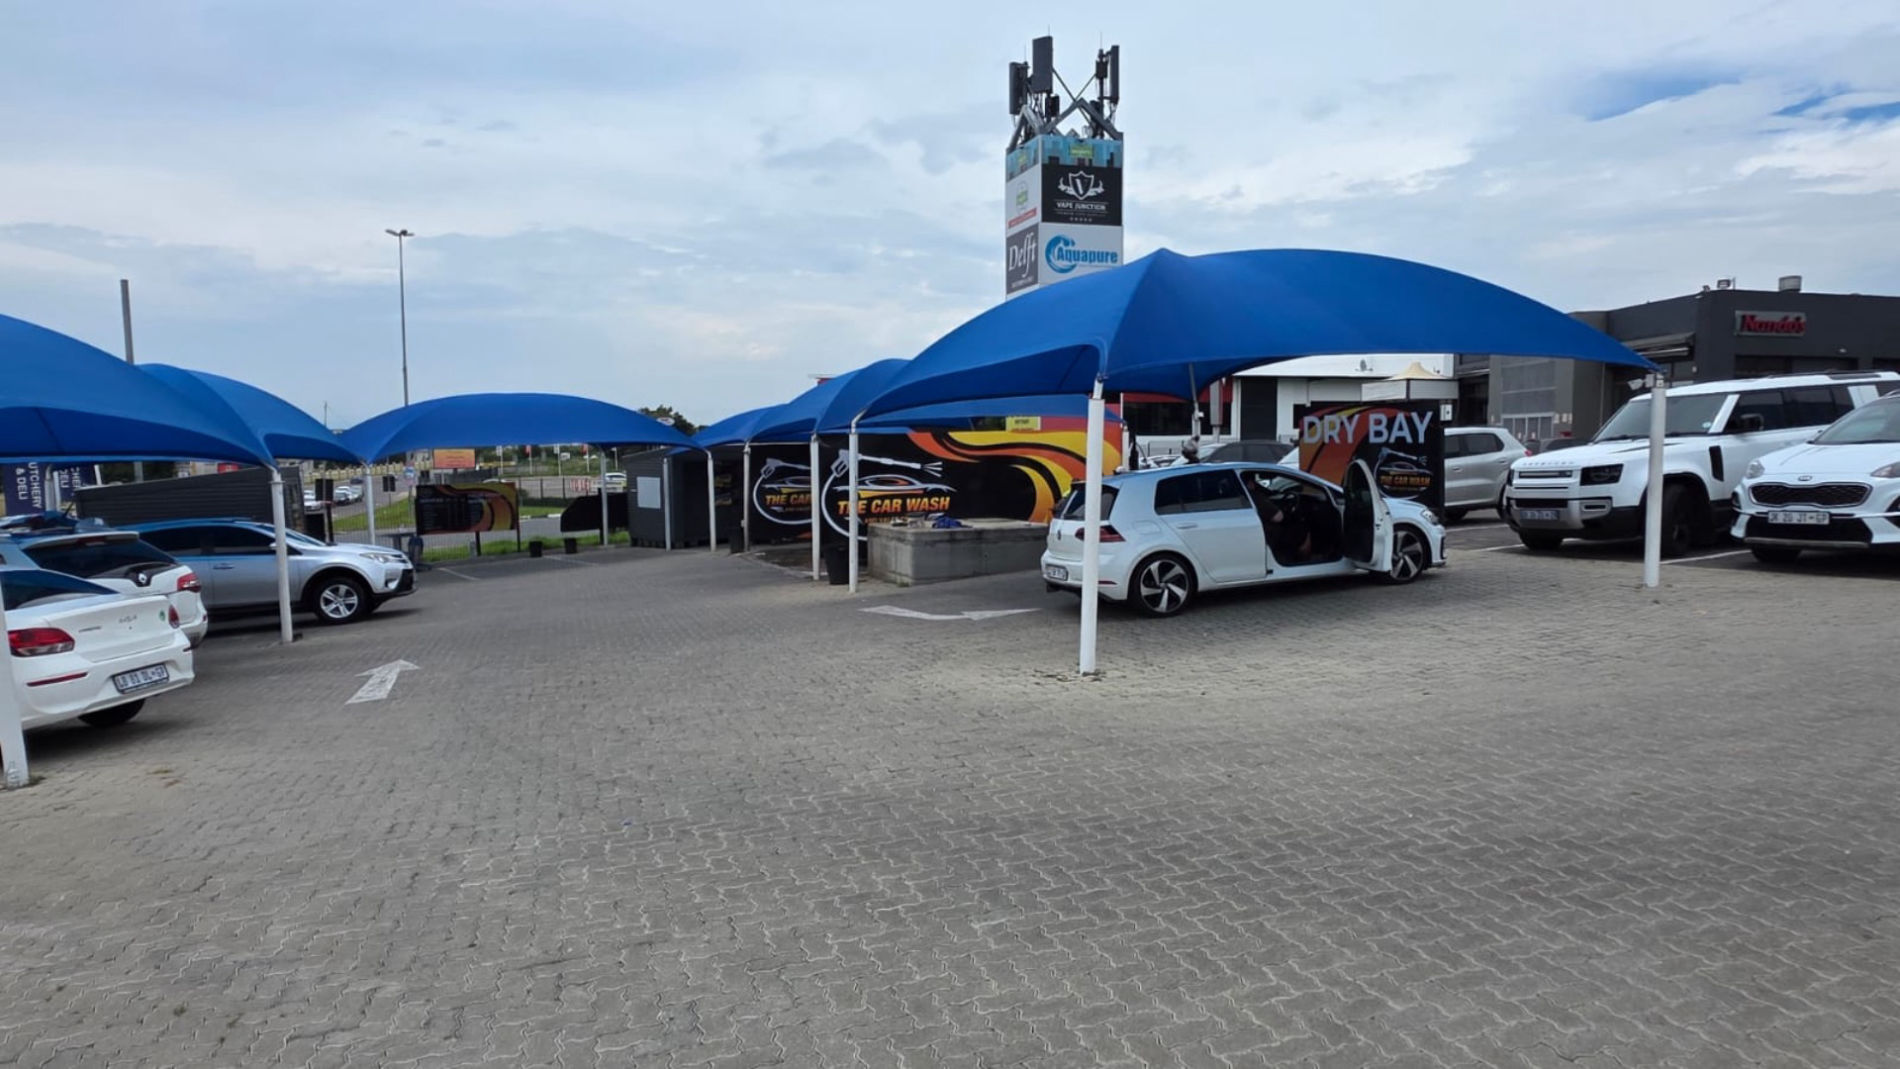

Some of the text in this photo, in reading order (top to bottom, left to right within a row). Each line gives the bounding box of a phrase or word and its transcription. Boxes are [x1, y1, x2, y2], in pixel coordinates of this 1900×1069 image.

[1056, 246, 1118, 264] Aquapure
[1303, 411, 1433, 444] DRY BAY
[17, 477, 28, 499] DELI
[765, 495, 788, 505] THE
[870, 498, 902, 513] CAR
[906, 496, 950, 511] WASH
